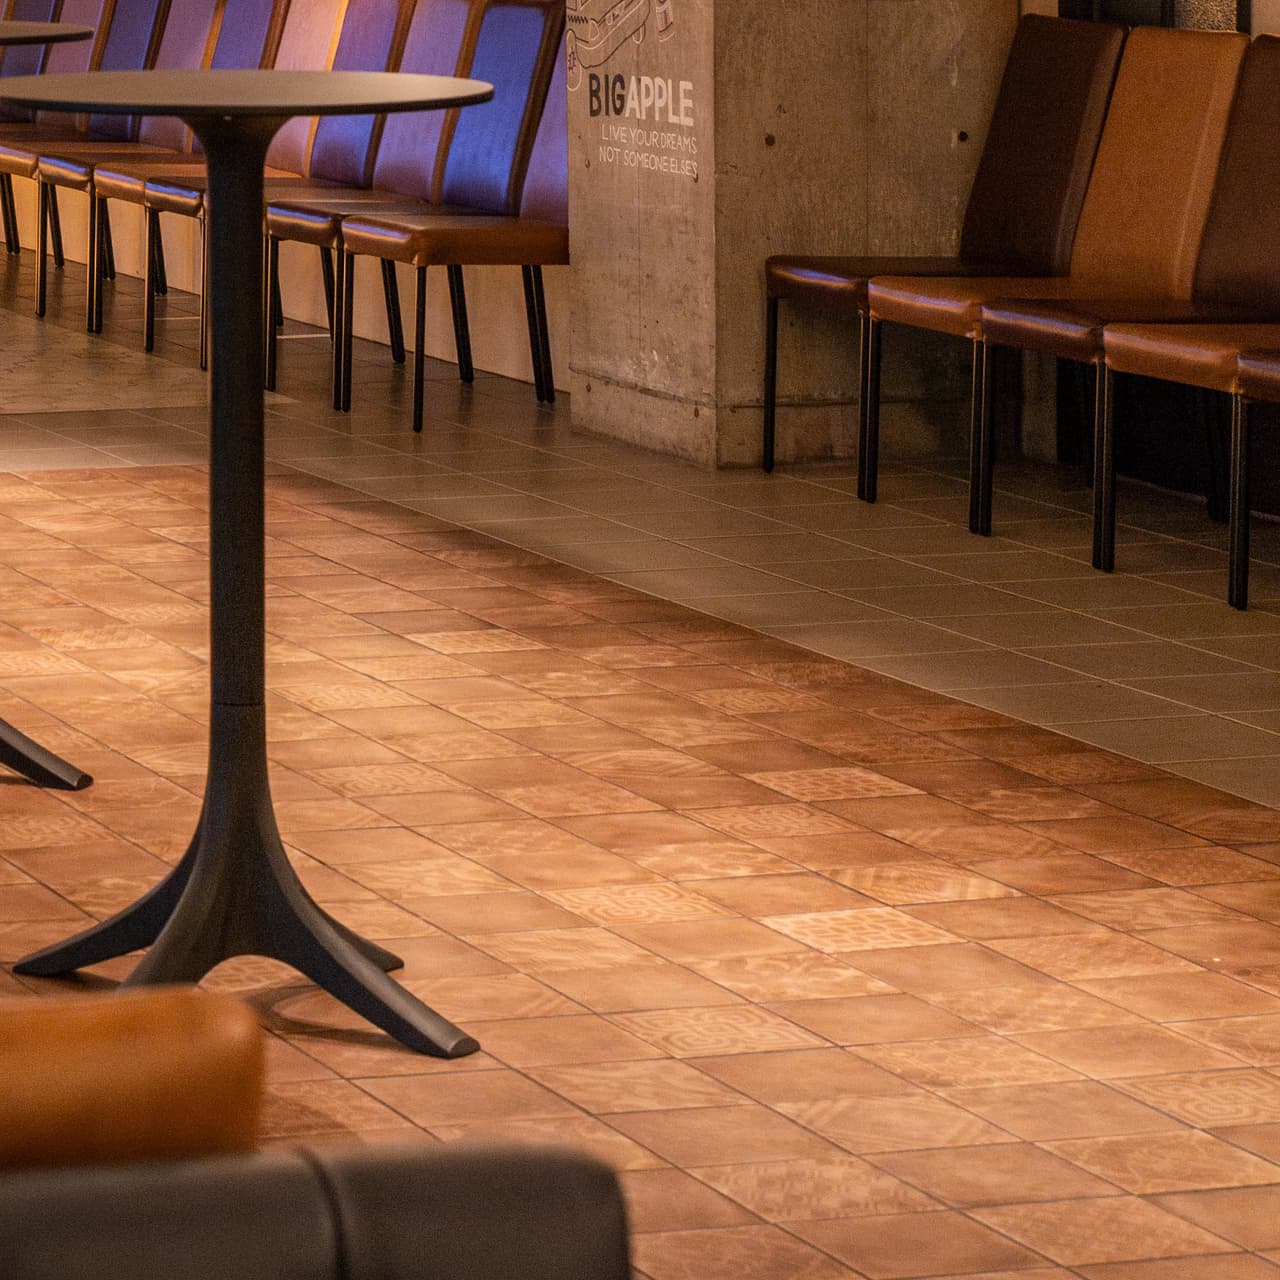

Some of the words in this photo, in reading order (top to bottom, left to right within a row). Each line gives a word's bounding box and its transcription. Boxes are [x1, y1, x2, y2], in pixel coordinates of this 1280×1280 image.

[601, 124, 628, 143] LIVE
[629, 127, 659, 149] YOUR
[660, 132, 697, 154] DREAMS
[600, 146, 621, 164] NOT
[623, 150, 668, 172] SOMEONE
